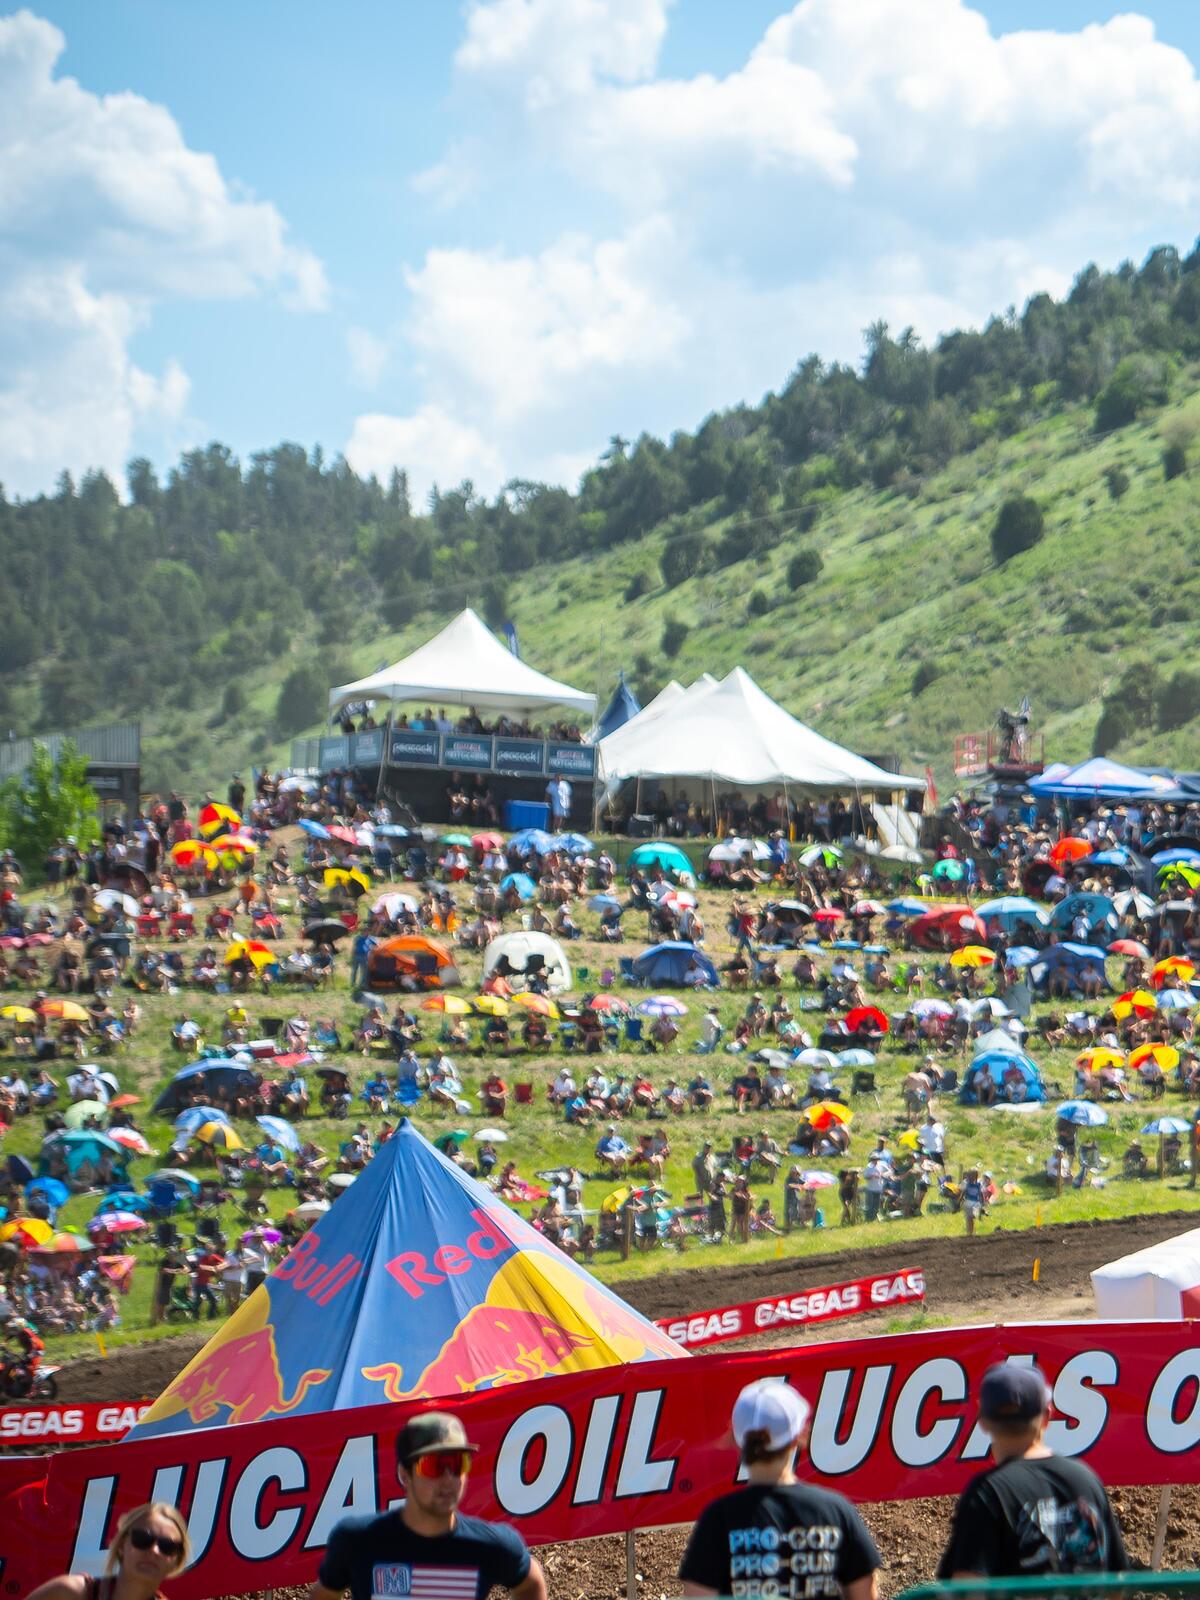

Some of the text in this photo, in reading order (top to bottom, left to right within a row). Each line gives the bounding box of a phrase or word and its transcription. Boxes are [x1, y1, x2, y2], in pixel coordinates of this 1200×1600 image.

[272, 1231, 362, 1307] Bull
[385, 1207, 513, 1300] Red
[656, 1272, 926, 1345] SGAS GASGAS GAS
[0, 1409, 84, 1437] SGAS
[69, 1388, 680, 1577] LUCA OIL
